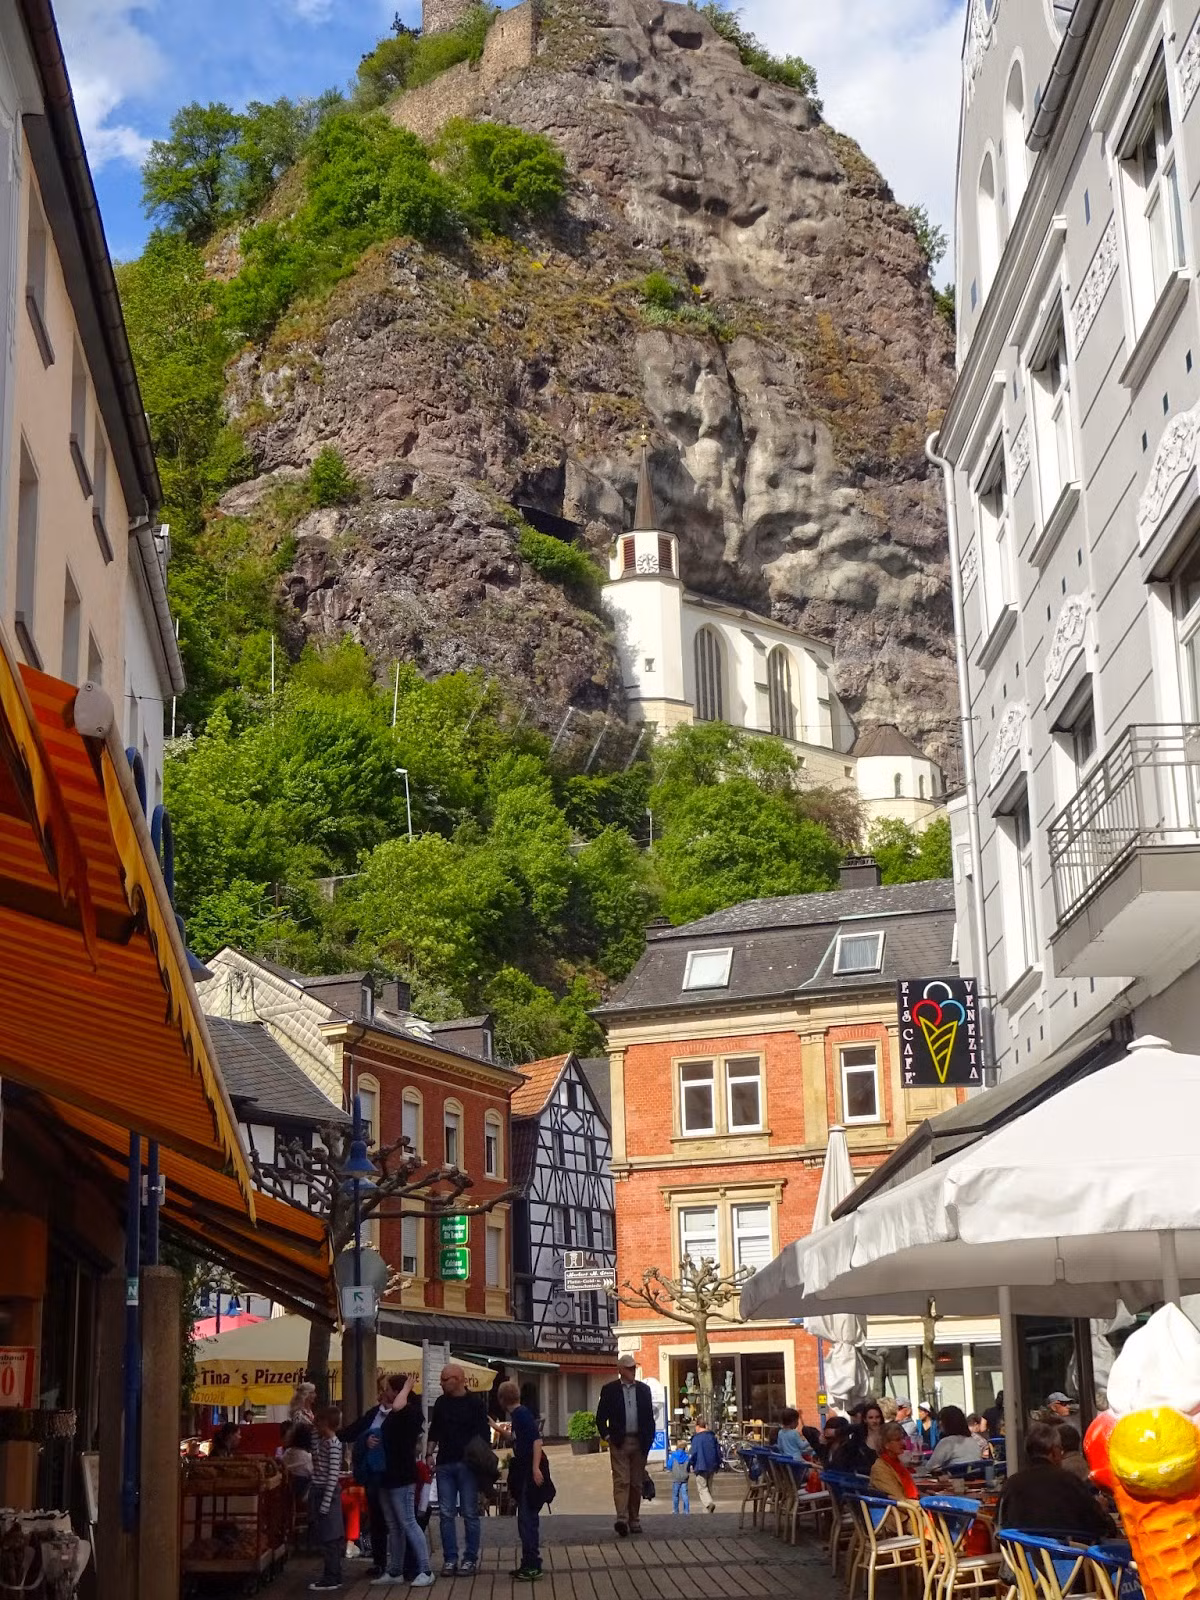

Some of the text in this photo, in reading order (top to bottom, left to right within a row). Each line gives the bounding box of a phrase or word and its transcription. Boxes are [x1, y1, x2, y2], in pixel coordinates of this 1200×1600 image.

[900, 981, 911, 1023] EIS
[964, 980, 979, 1079] VENEZIA
[201, 1369, 230, 1385] Tina
[464, 1373, 479, 1388] eria
